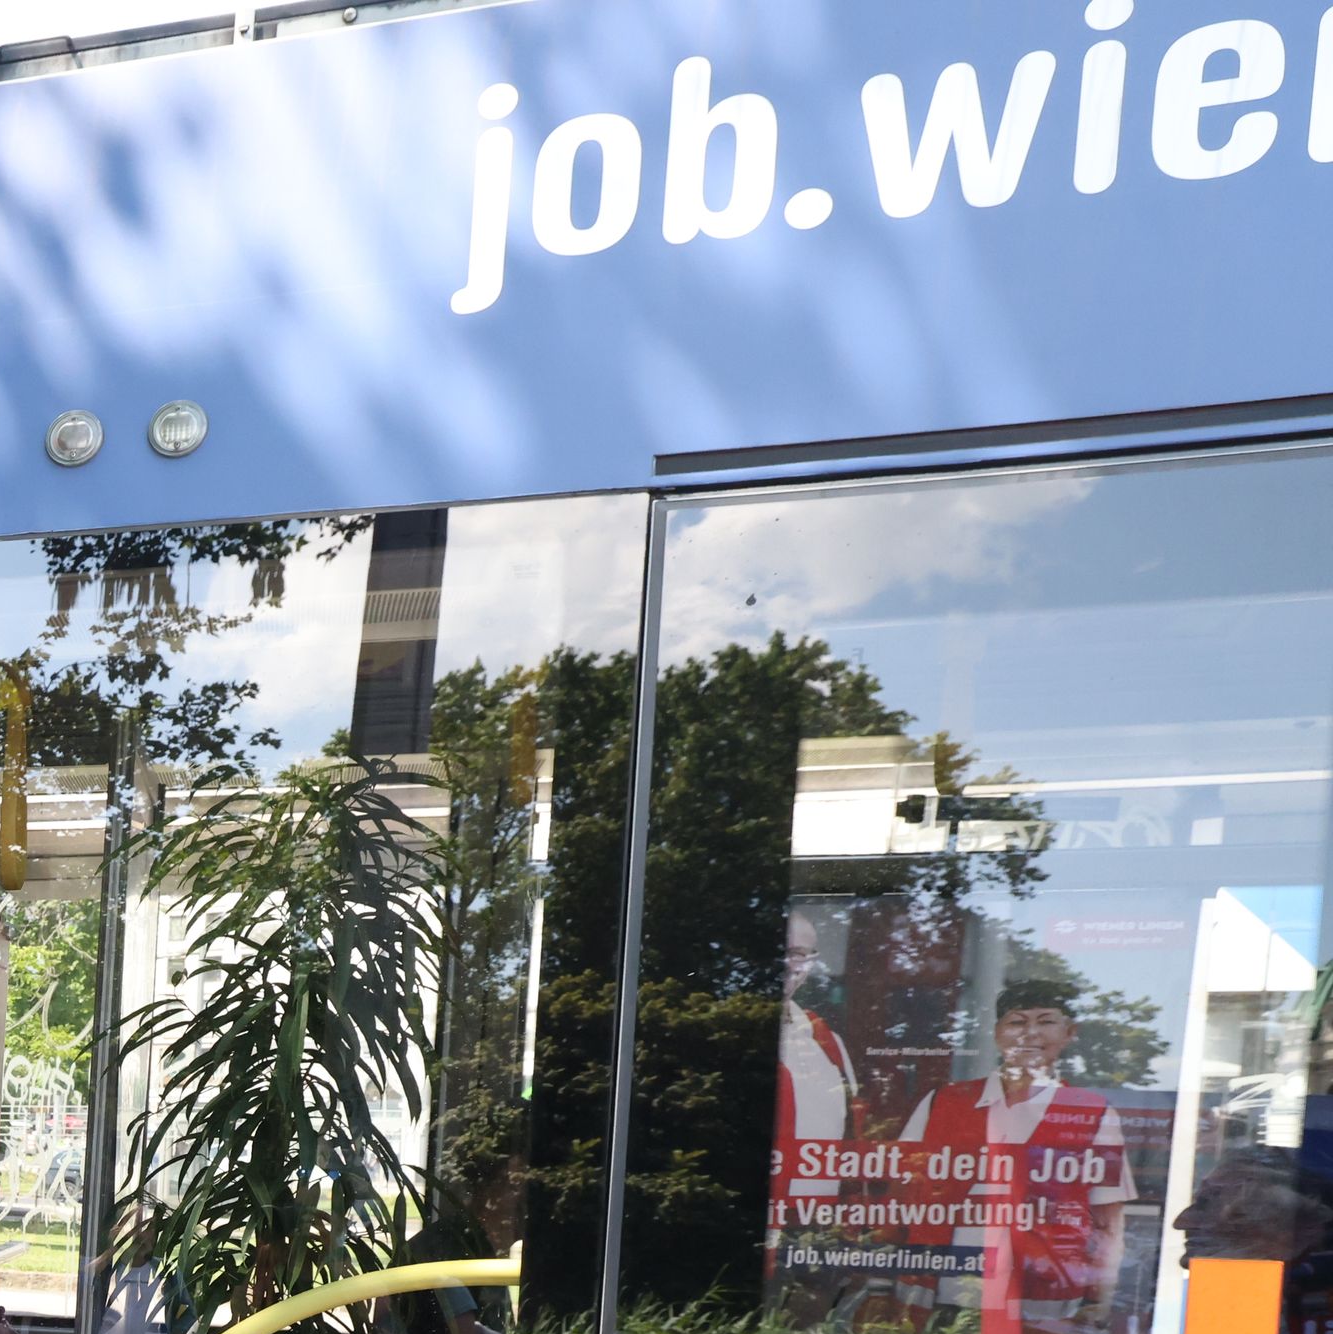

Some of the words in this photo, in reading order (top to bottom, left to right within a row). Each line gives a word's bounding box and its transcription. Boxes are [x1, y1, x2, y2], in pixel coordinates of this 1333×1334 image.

[450, 0, 1333, 315] job.wie
[797, 1142, 913, 1184] Stadt,
[928, 1145, 1014, 1182] dein
[1030, 1148, 1106, 1184] Job
[796, 1197, 1047, 1232] Verantwortung!
[785, 1245, 986, 1272] job.wienerlinien.at
